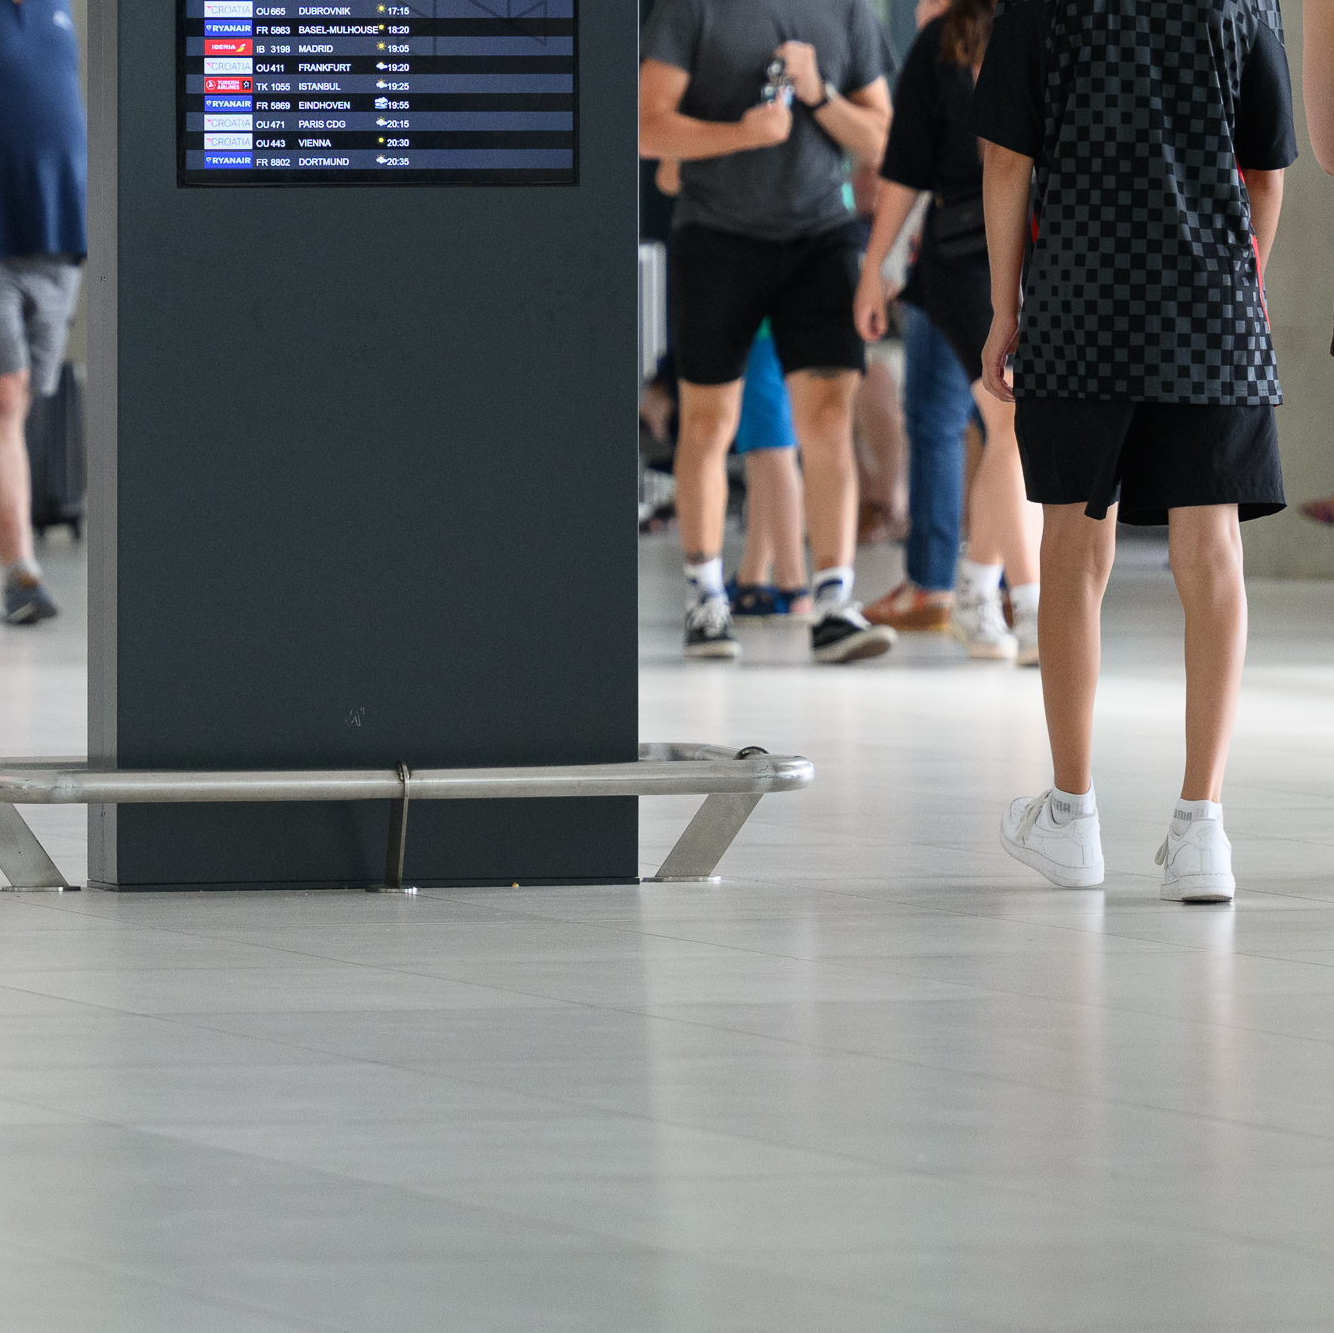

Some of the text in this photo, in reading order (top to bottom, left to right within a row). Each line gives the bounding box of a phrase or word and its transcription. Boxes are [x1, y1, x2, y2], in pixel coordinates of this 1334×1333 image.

[299, 6, 410, 16] DUBROVNIK 17:15
[270, 26, 291, 35] 5863
[298, 25, 378, 35] BASEL-MULHOUSE
[388, 25, 410, 35] 18:20
[271, 45, 291, 54] 3198
[299, 44, 334, 53] MADRID
[388, 44, 410, 53] 19:05
[298, 63, 410, 72] FRANKFURT 19:20
[271, 82, 410, 92] 1055 ISTANBUL 19:25
[270, 101, 291, 110] 5869
[298, 101, 351, 110] EINDHOVEN
[388, 100, 410, 110] 19:55
[298, 119, 410, 129] PARIS CDG 20:15
[211, 138, 410, 148] CROATIA VIENNA 20:30
[270, 158, 291, 167] 8802
[299, 157, 350, 167] DORTMUND
[387, 157, 410, 166] 20:35
